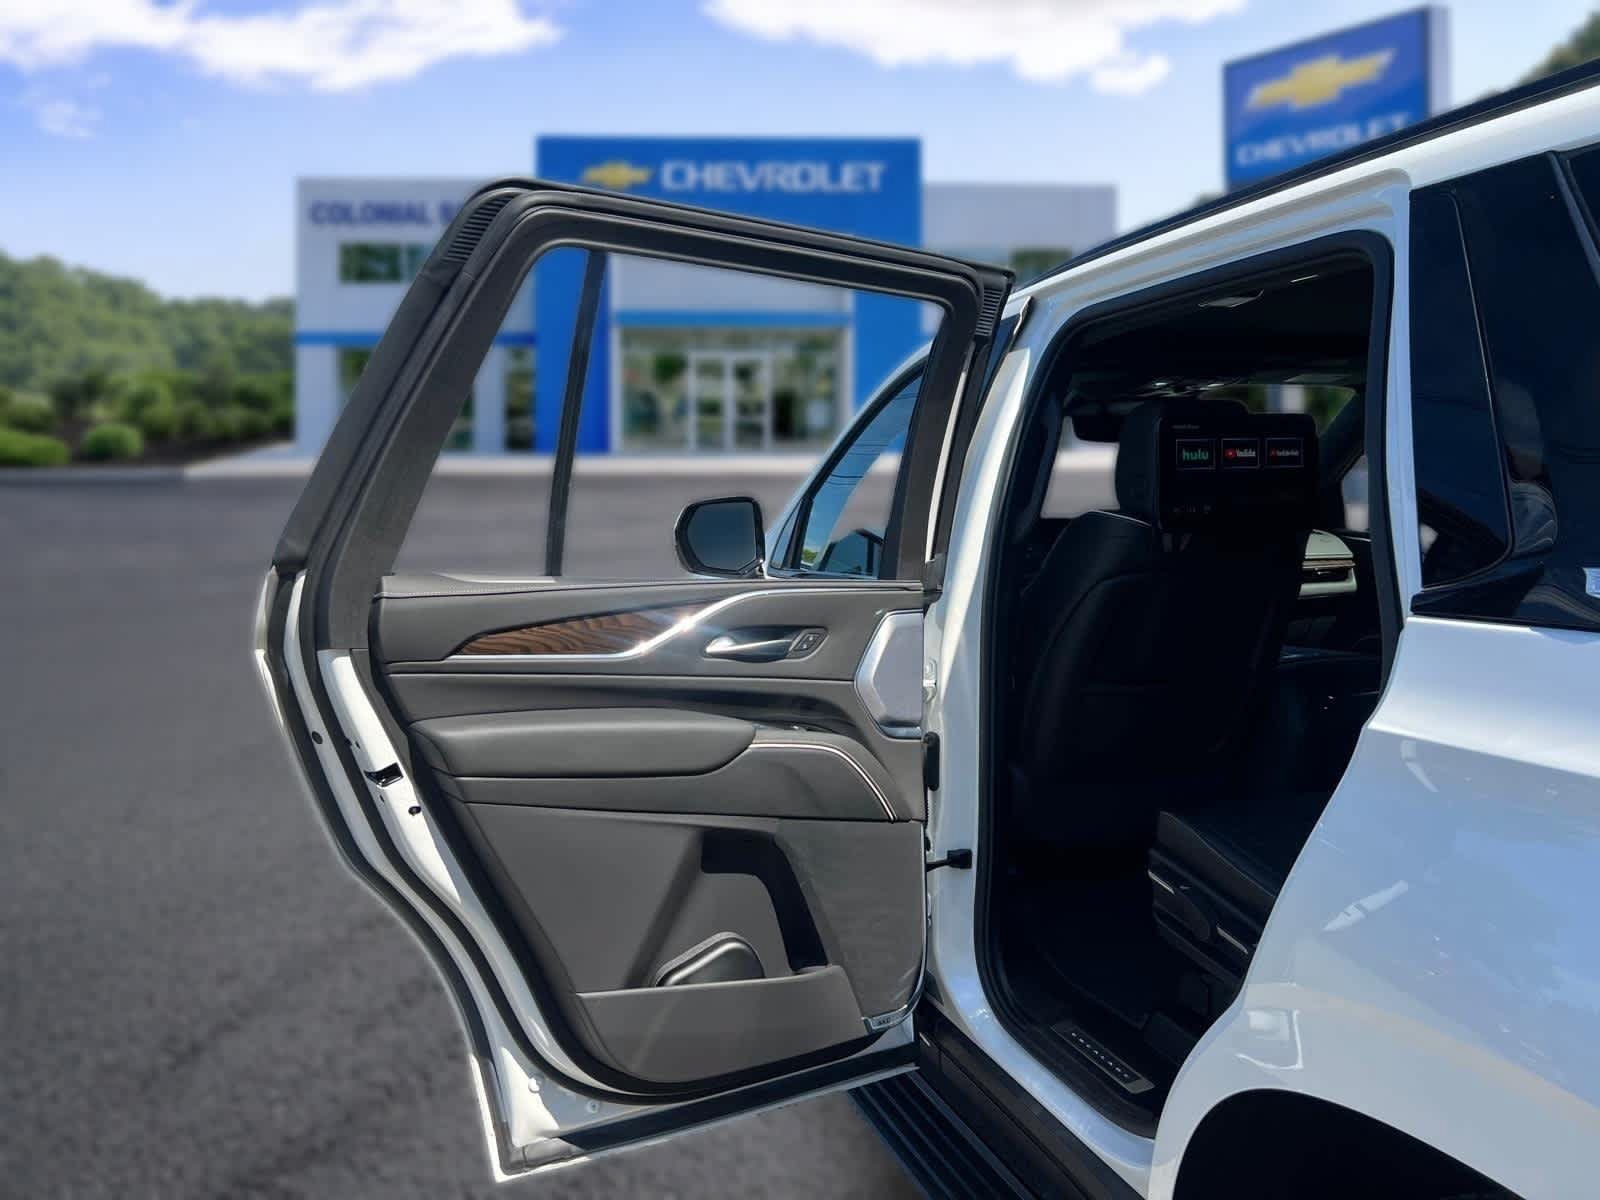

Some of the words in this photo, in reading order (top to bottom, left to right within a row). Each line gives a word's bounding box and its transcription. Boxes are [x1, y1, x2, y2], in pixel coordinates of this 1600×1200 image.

[1236, 112, 1410, 166] CHEVROLET
[661, 160, 885, 194] CHEVROLET
[309, 201, 433, 226] COLONIAL
[1182, 448, 1209, 461] hulu
